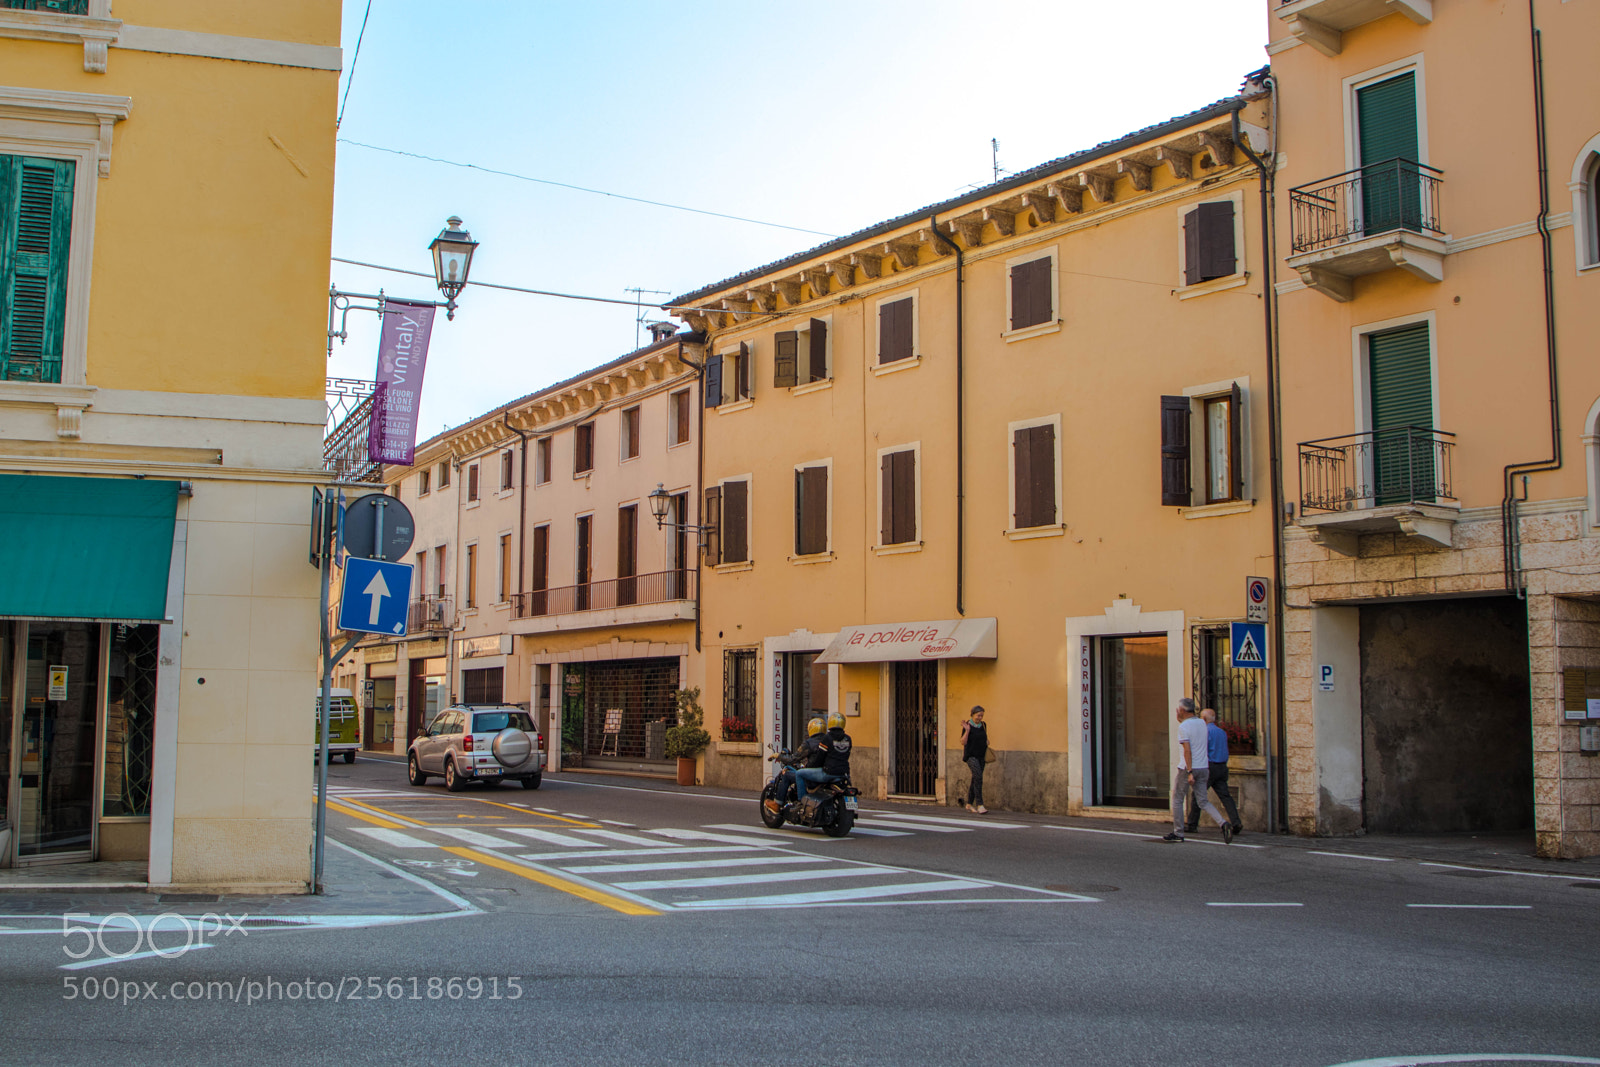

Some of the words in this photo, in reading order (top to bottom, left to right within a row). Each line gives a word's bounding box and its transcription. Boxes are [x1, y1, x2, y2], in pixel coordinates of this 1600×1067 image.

[392, 316, 420, 385] vinitaly
[384, 388, 390, 396] IL
[392, 389, 414, 398] FUORI
[383, 396, 413, 405] SALONE
[395, 404, 412, 413] VINO
[381, 420, 410, 429] PALAZZO
[380, 448, 407, 460] APRILE
[846, 630, 865, 646] la
[865, 625, 939, 648] polleria
[1322, 666, 1332, 682] P
